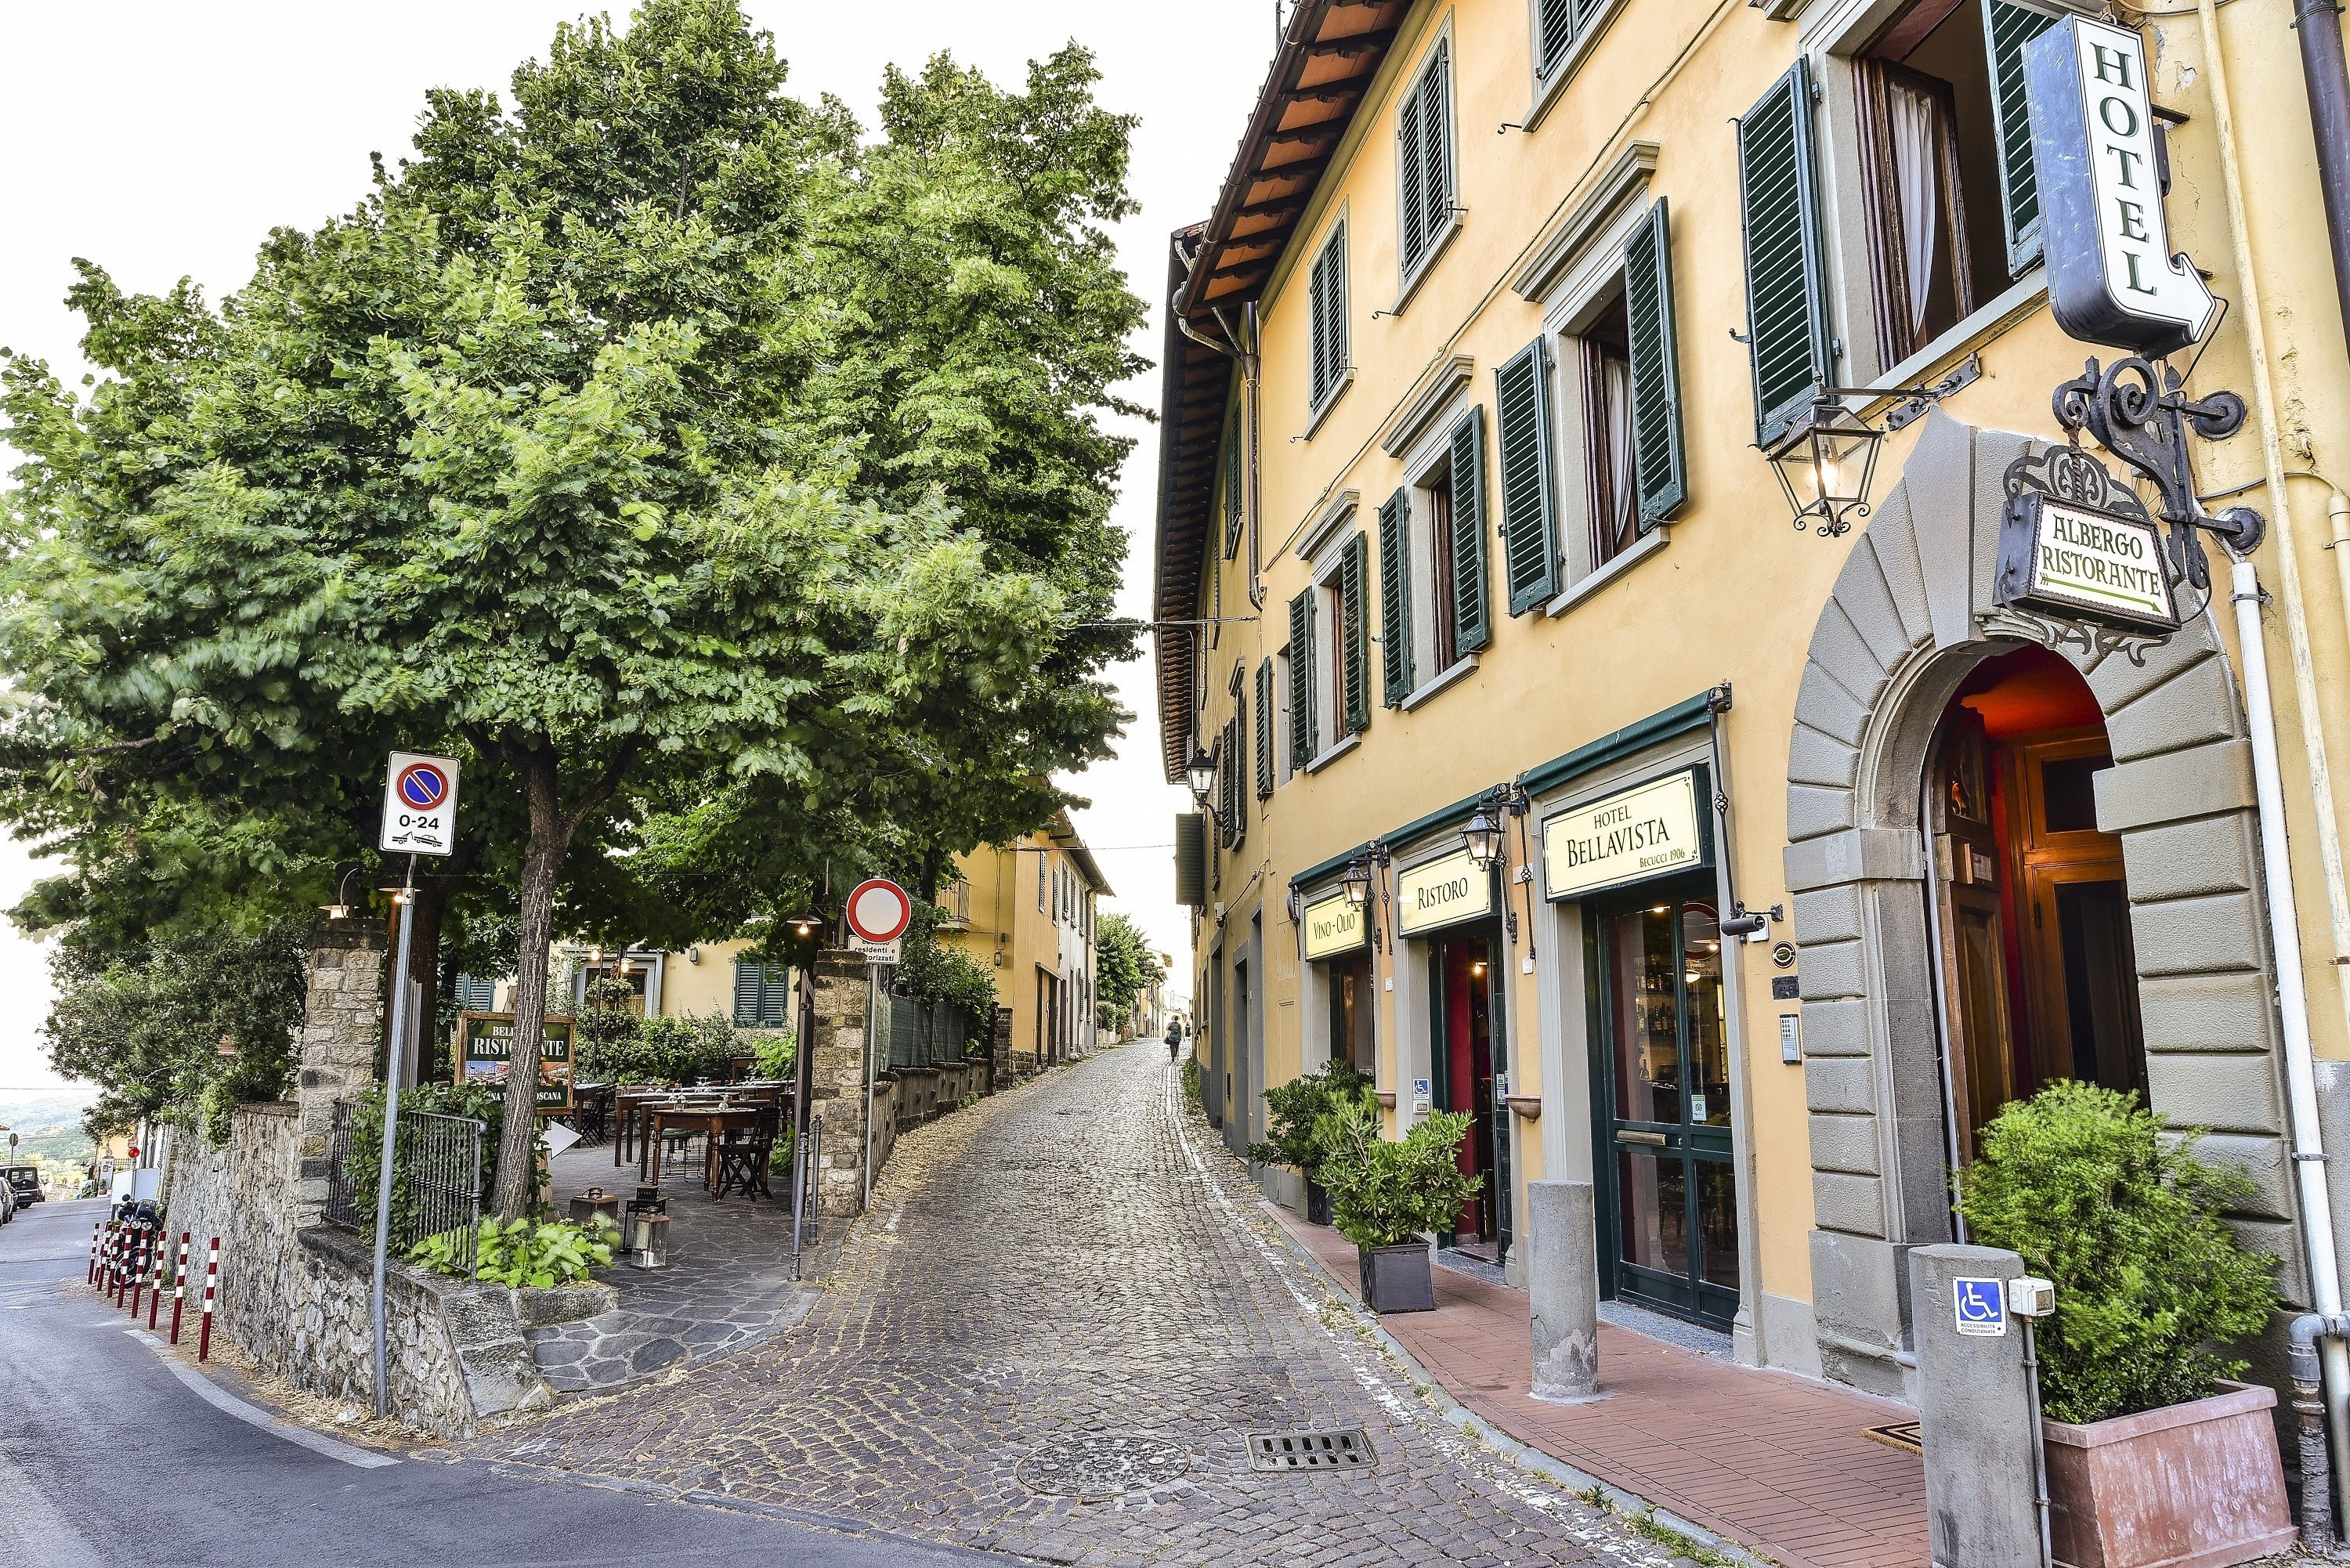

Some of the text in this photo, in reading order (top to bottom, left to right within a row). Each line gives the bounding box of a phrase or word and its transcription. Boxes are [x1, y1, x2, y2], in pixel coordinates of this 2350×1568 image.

[2089, 42, 2157, 297] HOTEL
[2052, 513, 2143, 559] ALBERGO
[2040, 543, 2161, 598] RISTORANTE
[399, 815, 439, 830] 0-24
[1593, 805, 1632, 829] HOTEL
[1567, 817, 1671, 869] BELLAVISTA
[1640, 847, 1686, 868] BECUCCI 1906
[1418, 877, 1468, 910] RISTORO
[1314, 921, 1331, 940] VINO
[1336, 913, 1355, 933] OLIO
[473, 1038, 564, 1056] RISTNTE
